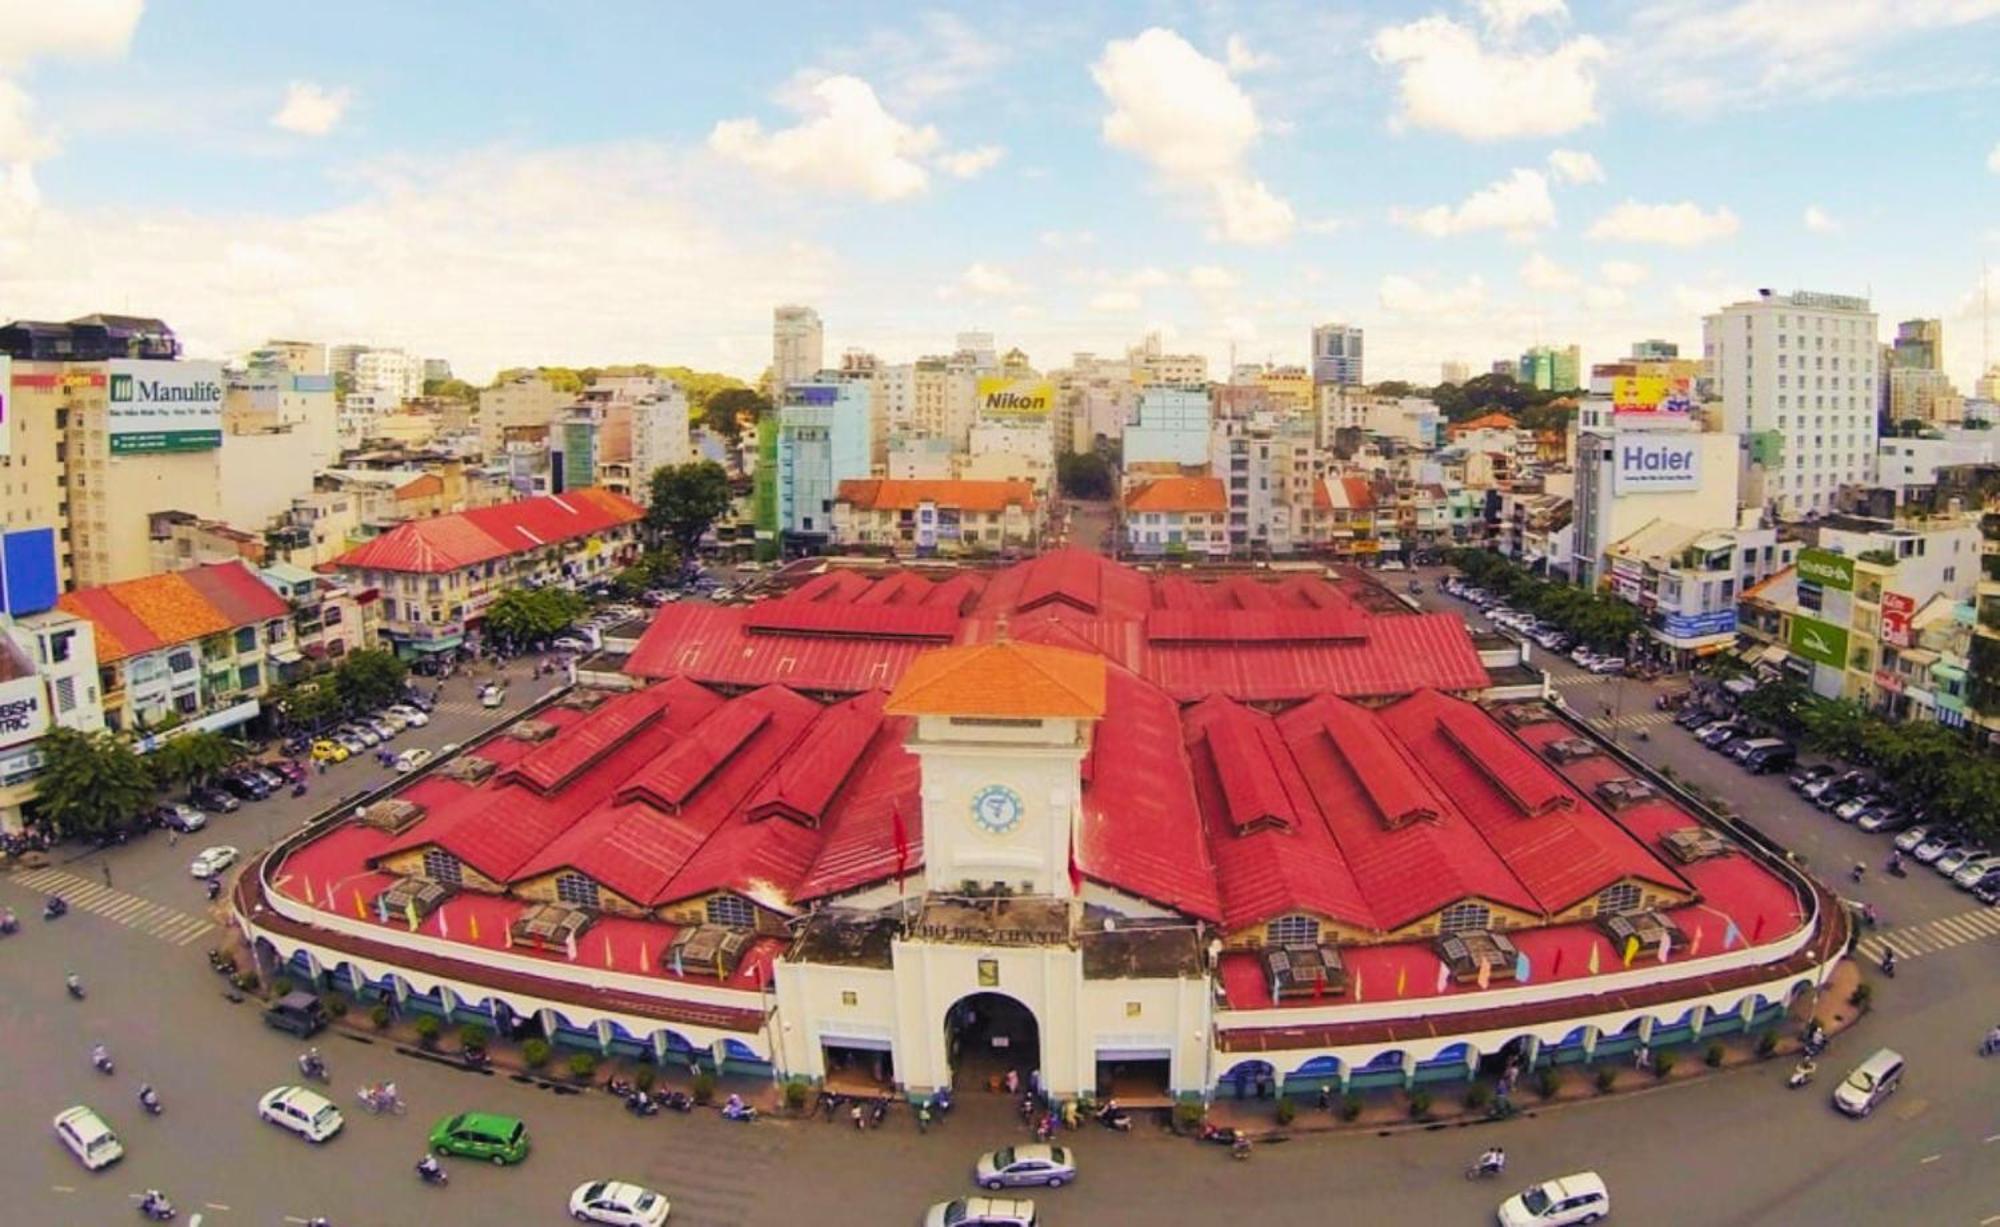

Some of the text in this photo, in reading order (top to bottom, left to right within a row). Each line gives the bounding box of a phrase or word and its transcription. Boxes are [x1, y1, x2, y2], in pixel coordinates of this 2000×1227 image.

[138, 381, 221, 402] Manulife
[986, 393, 1045, 410] Nikon
[1624, 447, 1693, 470] Haier
[0, 697, 38, 718] BISHI
